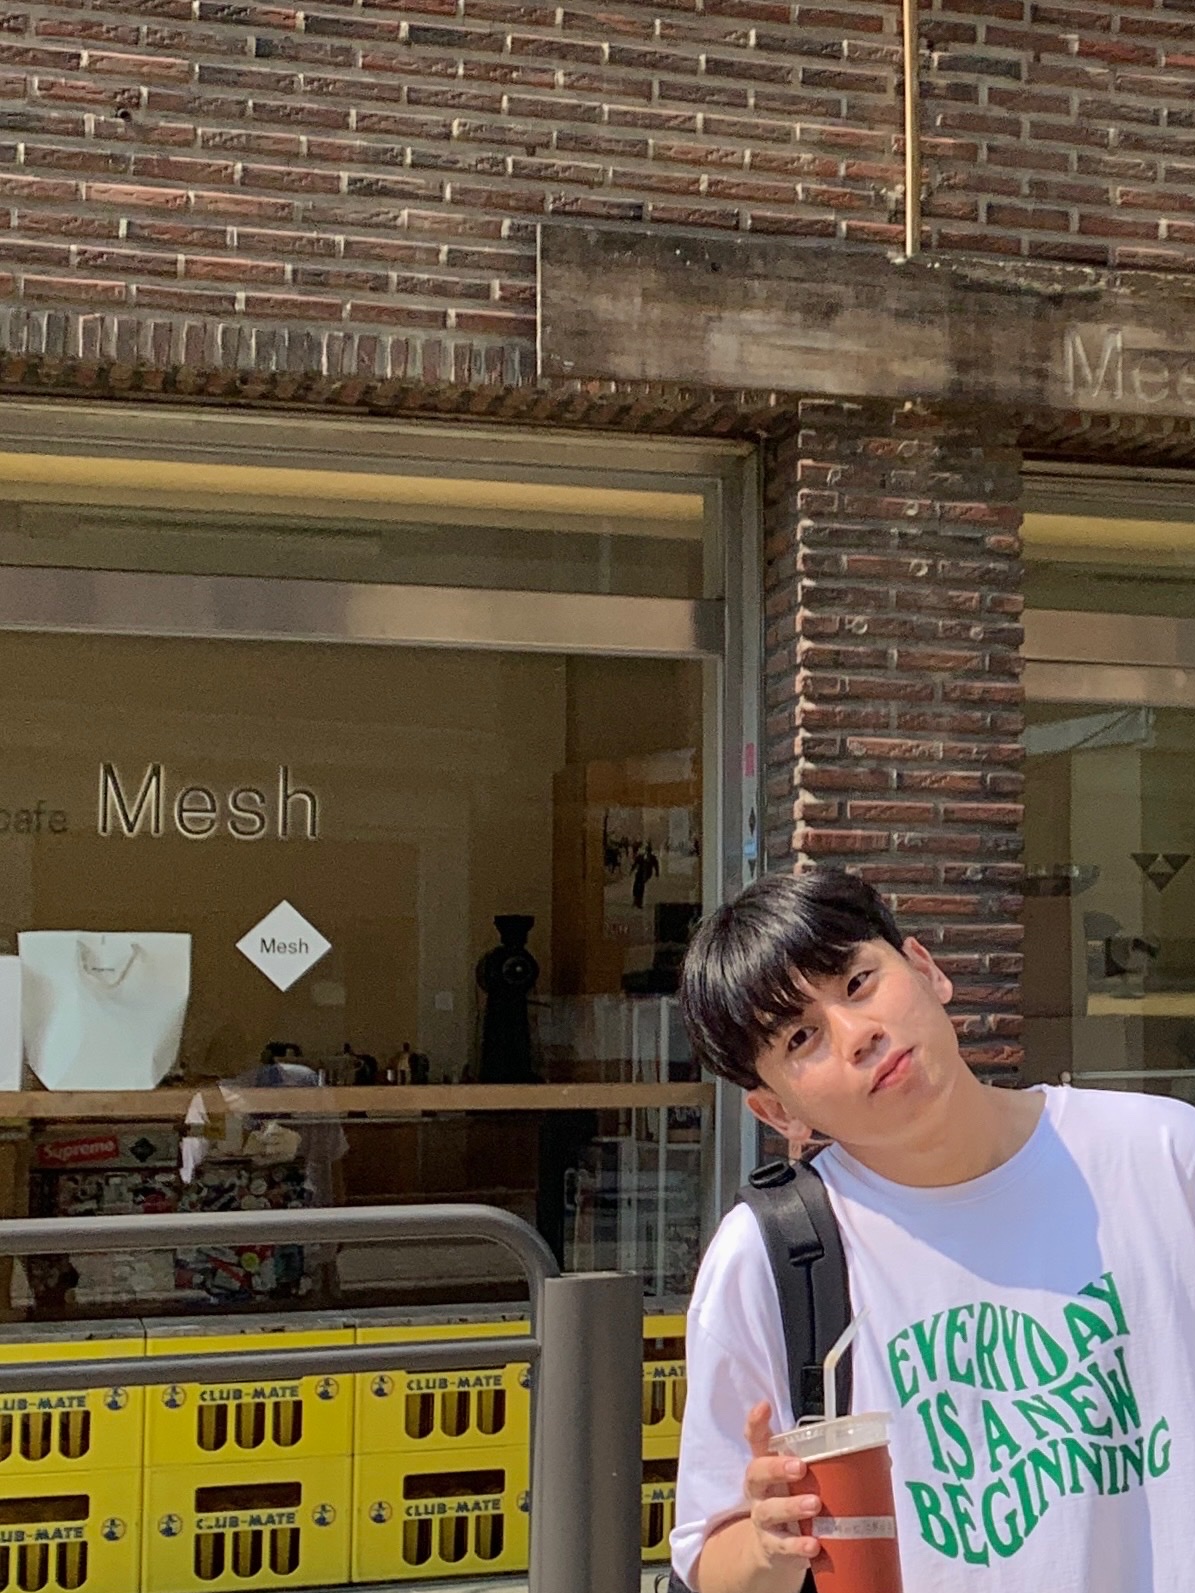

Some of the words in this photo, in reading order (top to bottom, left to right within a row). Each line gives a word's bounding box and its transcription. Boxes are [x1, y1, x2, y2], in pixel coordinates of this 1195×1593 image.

[98, 762, 320, 840] Mesh
[259, 938, 309, 954] Mesh
[887, 1271, 1132, 1409] EVERYDAY
[200, 1386, 299, 1402] CLUB-MATE
[406, 1374, 504, 1392] CLUB-MATE
[917, 1389, 976, 1482] IS
[981, 1400, 1023, 1473] A
[1011, 1346, 1142, 1440] NEW
[405, 1498, 503, 1518] CLUB-MATE
[904, 1415, 1173, 1568] BEGINNING
